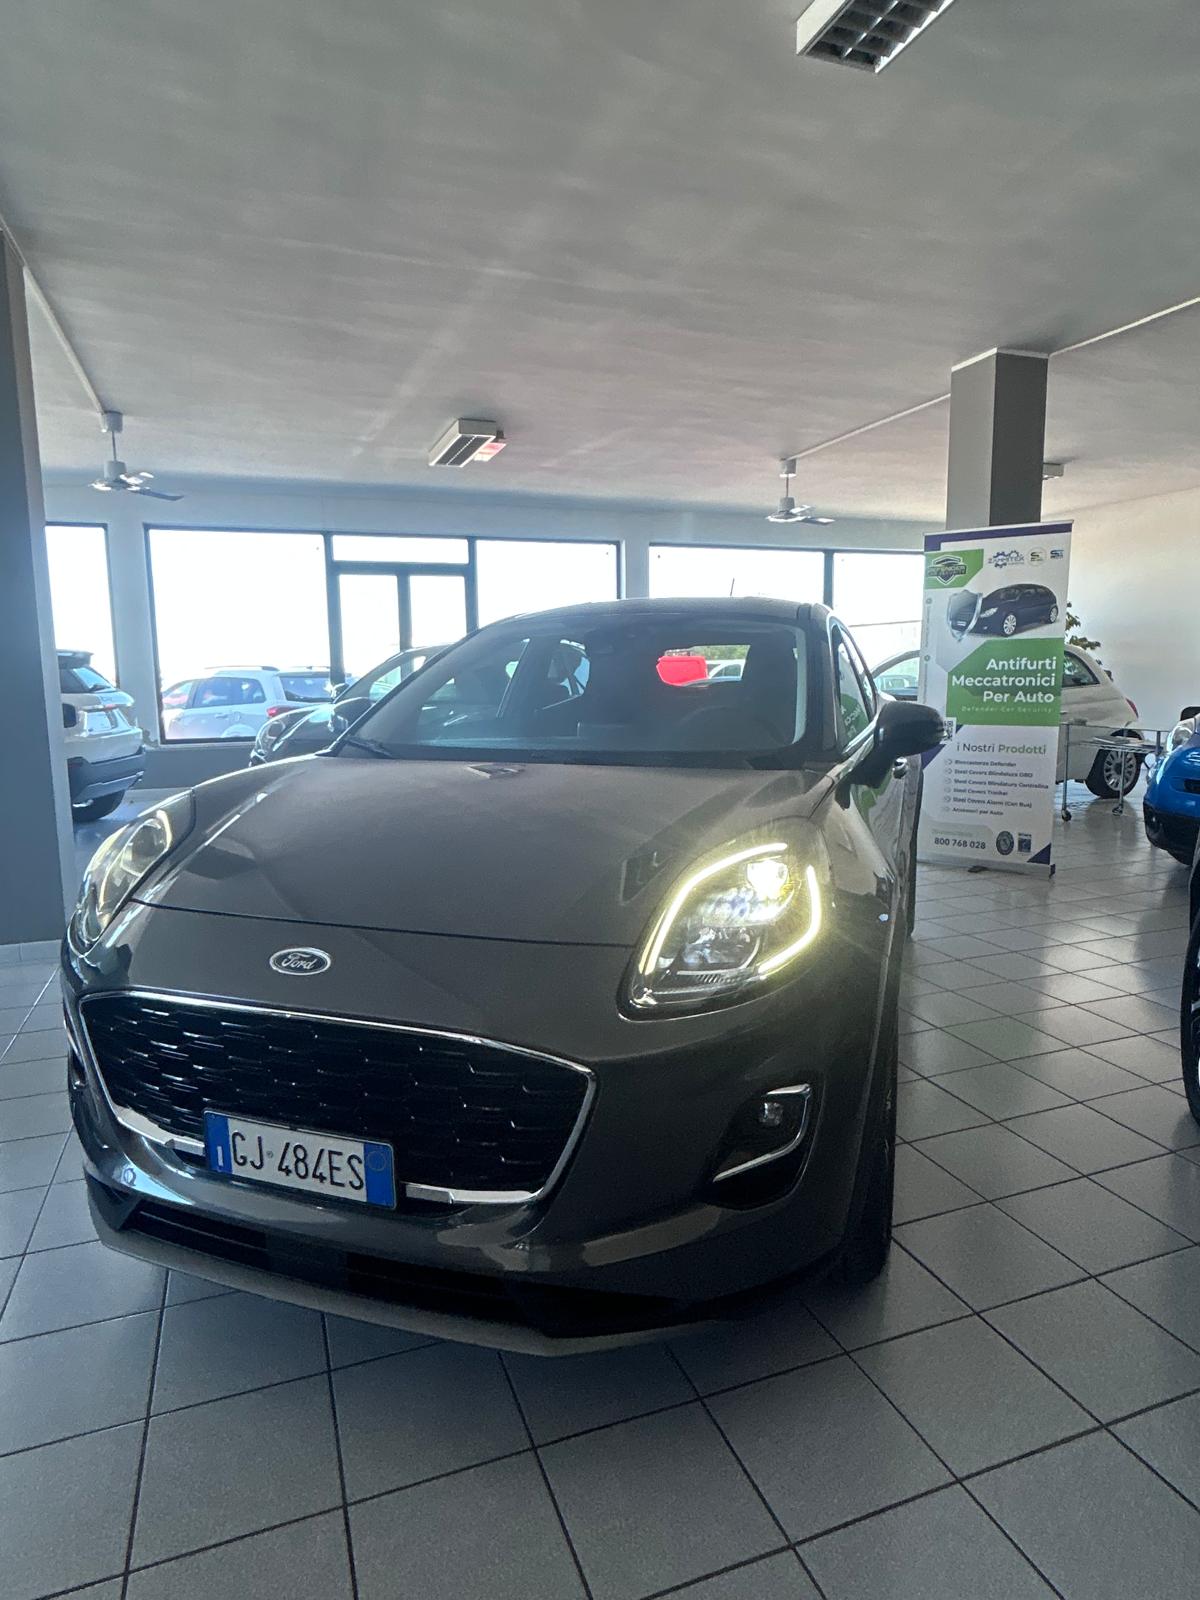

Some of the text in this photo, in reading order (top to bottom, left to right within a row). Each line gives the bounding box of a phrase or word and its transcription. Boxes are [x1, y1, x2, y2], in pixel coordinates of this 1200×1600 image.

[986, 657, 1057, 671] Antifurti
[951, 673, 1055, 687] Meccatronici
[983, 691, 1055, 703] Per Auto
[962, 743, 995, 753] Nostri
[998, 744, 1047, 755] Prodotti
[934, 837, 986, 850] 800 768 028
[281, 952, 315, 971] Ford
[231, 1131, 365, 1191] GJ 484ES
